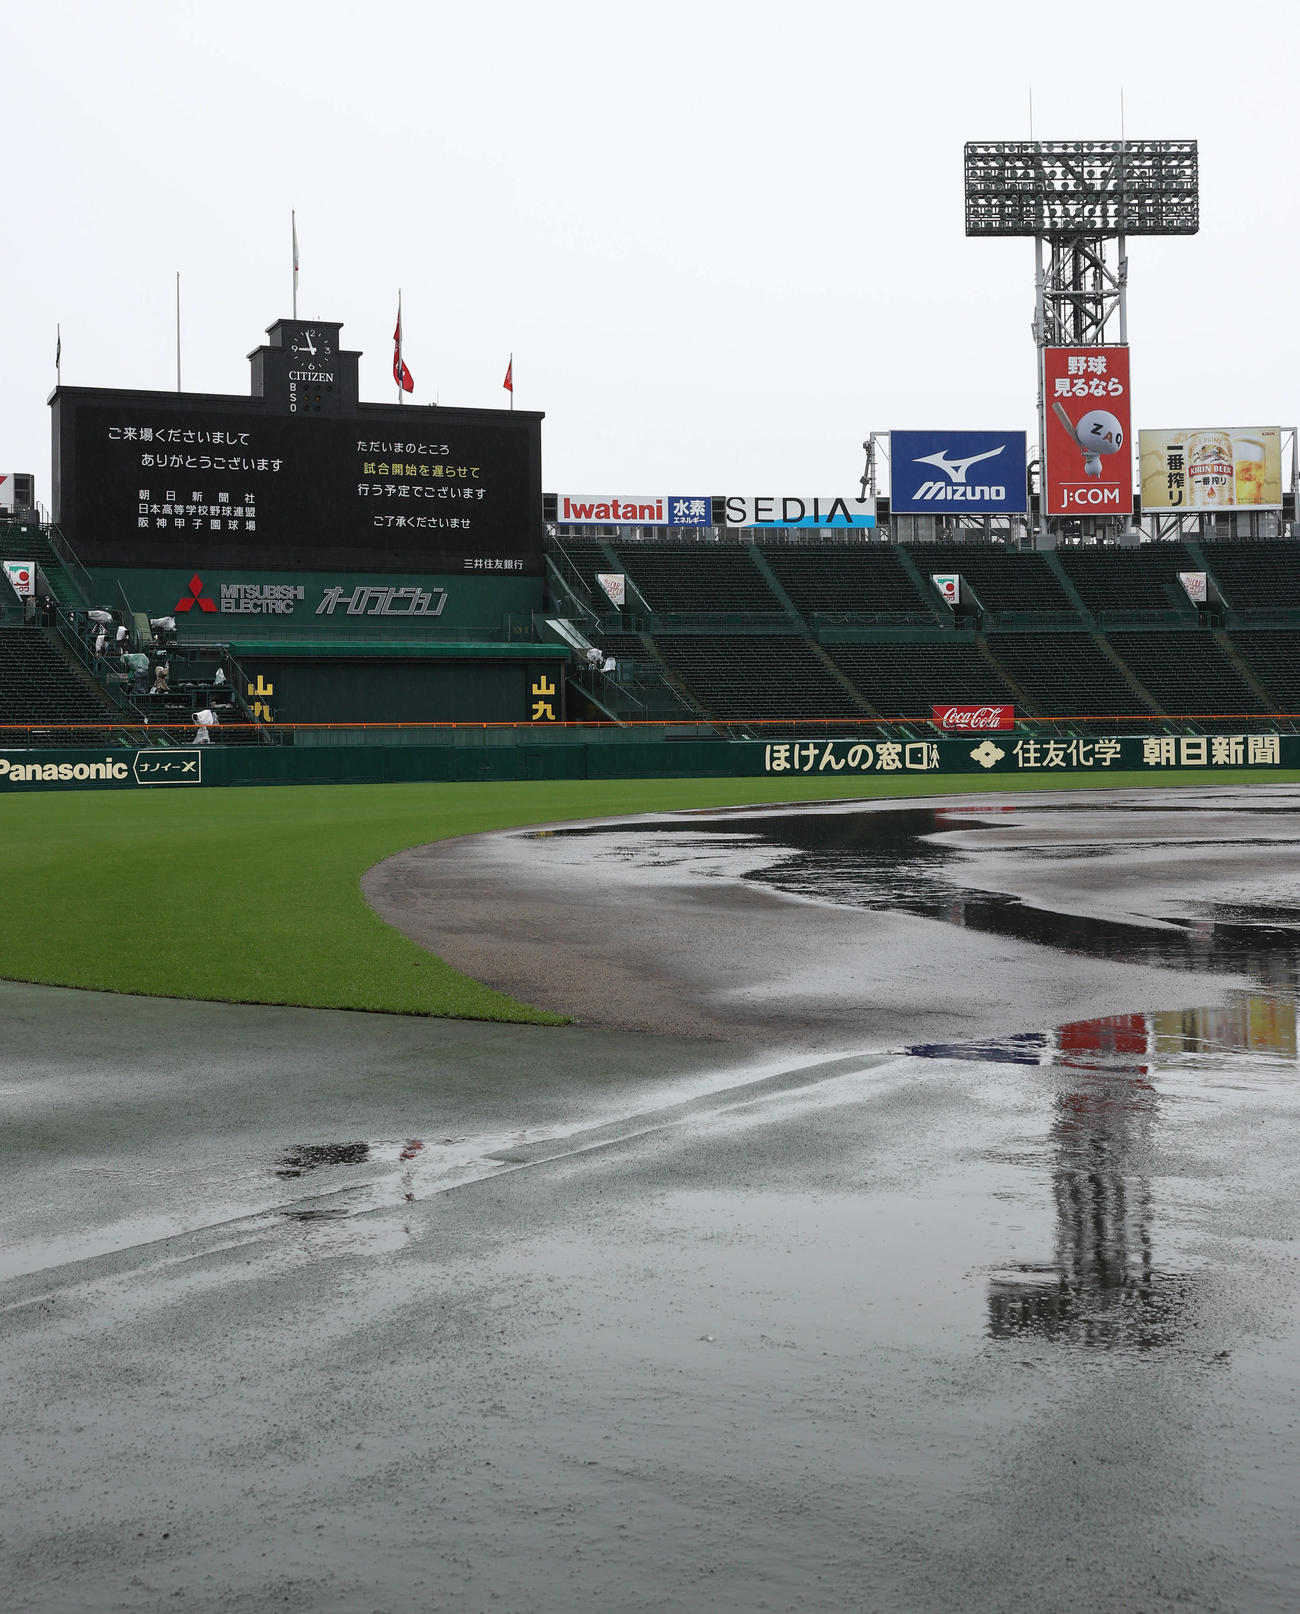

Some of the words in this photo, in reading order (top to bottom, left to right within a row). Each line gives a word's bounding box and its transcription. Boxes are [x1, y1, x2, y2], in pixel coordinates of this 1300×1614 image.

[291, 345, 298, 353] 9
[324, 347, 331, 355] 3
[308, 363, 315, 371] 6
[1067, 356, 1107, 375] 野球
[288, 371, 334, 382] CITIZEN
[1053, 378, 1123, 397] 見るなら
[108, 427, 250, 446] ご来場くださいまして
[357, 440, 450, 455] ただいまのところ
[141, 453, 283, 472] ありがとうございます
[363, 462, 480, 479] 試合開始を遅らせて
[1190, 465, 1212, 475] KIRIN
[1214, 464, 1233, 474] BEER
[1166, 445, 1185, 507] 一番搾り
[1195, 476, 1227, 485] 一番搾り
[138, 489, 256, 504] 朝日新聞社
[357, 483, 486, 500] 行う予定でございます
[1061, 487, 1120, 508] J:COM
[138, 503, 256, 517] 日本高等学校野球連盟
[563, 497, 663, 520] Iwatani
[673, 499, 706, 516] 水素
[726, 497, 853, 523] SEDIA
[137, 517, 256, 531] 阪神甲子園球場
[373, 515, 471, 529] ご了承くださいませ
[673, 516, 706, 524] エネルギー
[463, 558, 524, 570] 三井住友銀行
[220, 584, 305, 600] MITSUBISHI
[220, 598, 294, 614] ELECTRIC
[315, 586, 448, 616] オーロラビジョン
[532, 675, 556, 720] 山九
[943, 707, 1005, 729] Coca-Cola
[1012, 739, 1122, 767] 住友化学
[1143, 736, 1281, 766] 朝日新聞
